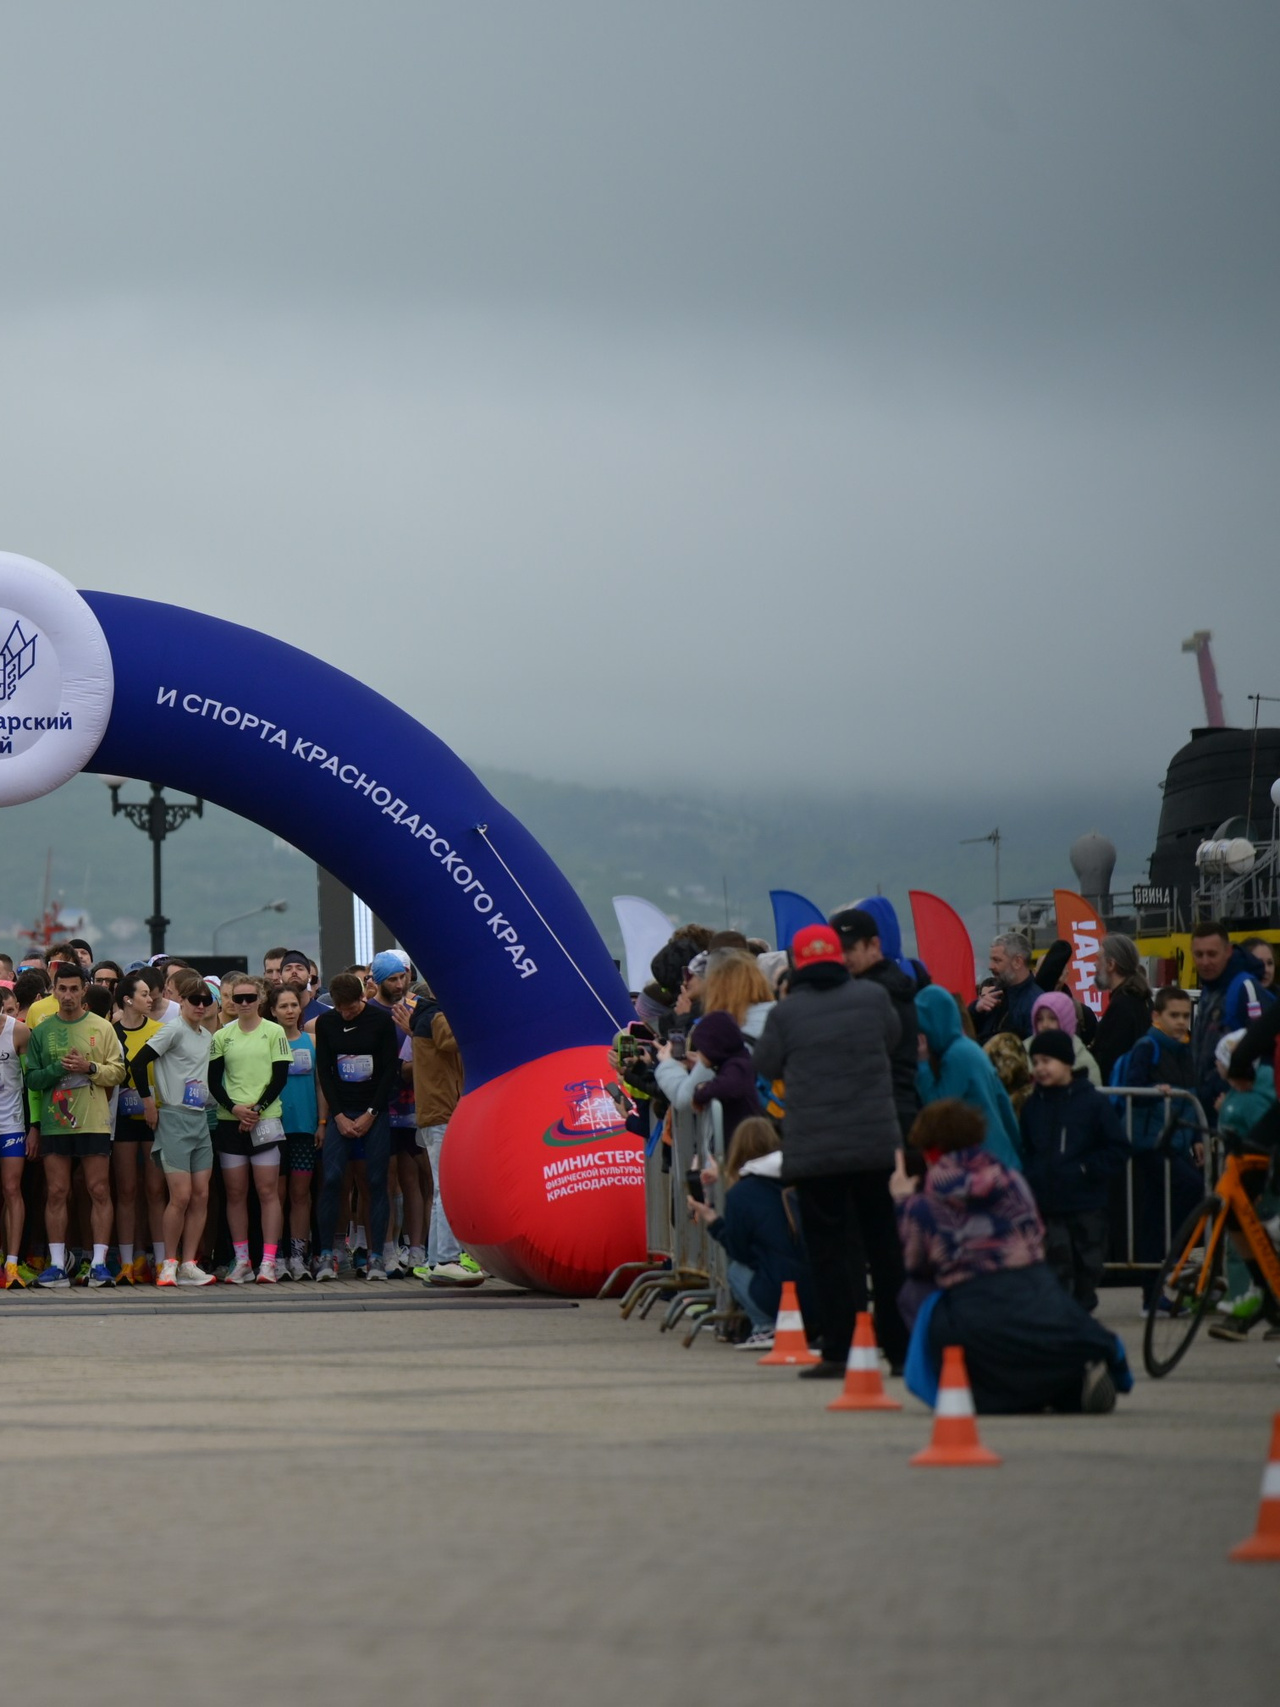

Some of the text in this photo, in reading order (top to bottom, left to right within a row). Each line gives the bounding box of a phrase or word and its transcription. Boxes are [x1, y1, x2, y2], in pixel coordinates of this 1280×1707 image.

[156, 686, 538, 979] И СПОРТА КРАСНОДАРСКОГО КРАЯ
[543, 1150, 645, 1179] МИНИСТЕРС
[545, 1167, 599, 1190] ФИЗИЧЕСКОЙ
[600, 1166, 641, 1176] КУЛЬТУРЫ
[546, 1176, 645, 1202] КРАСНОДАРСКОГ
